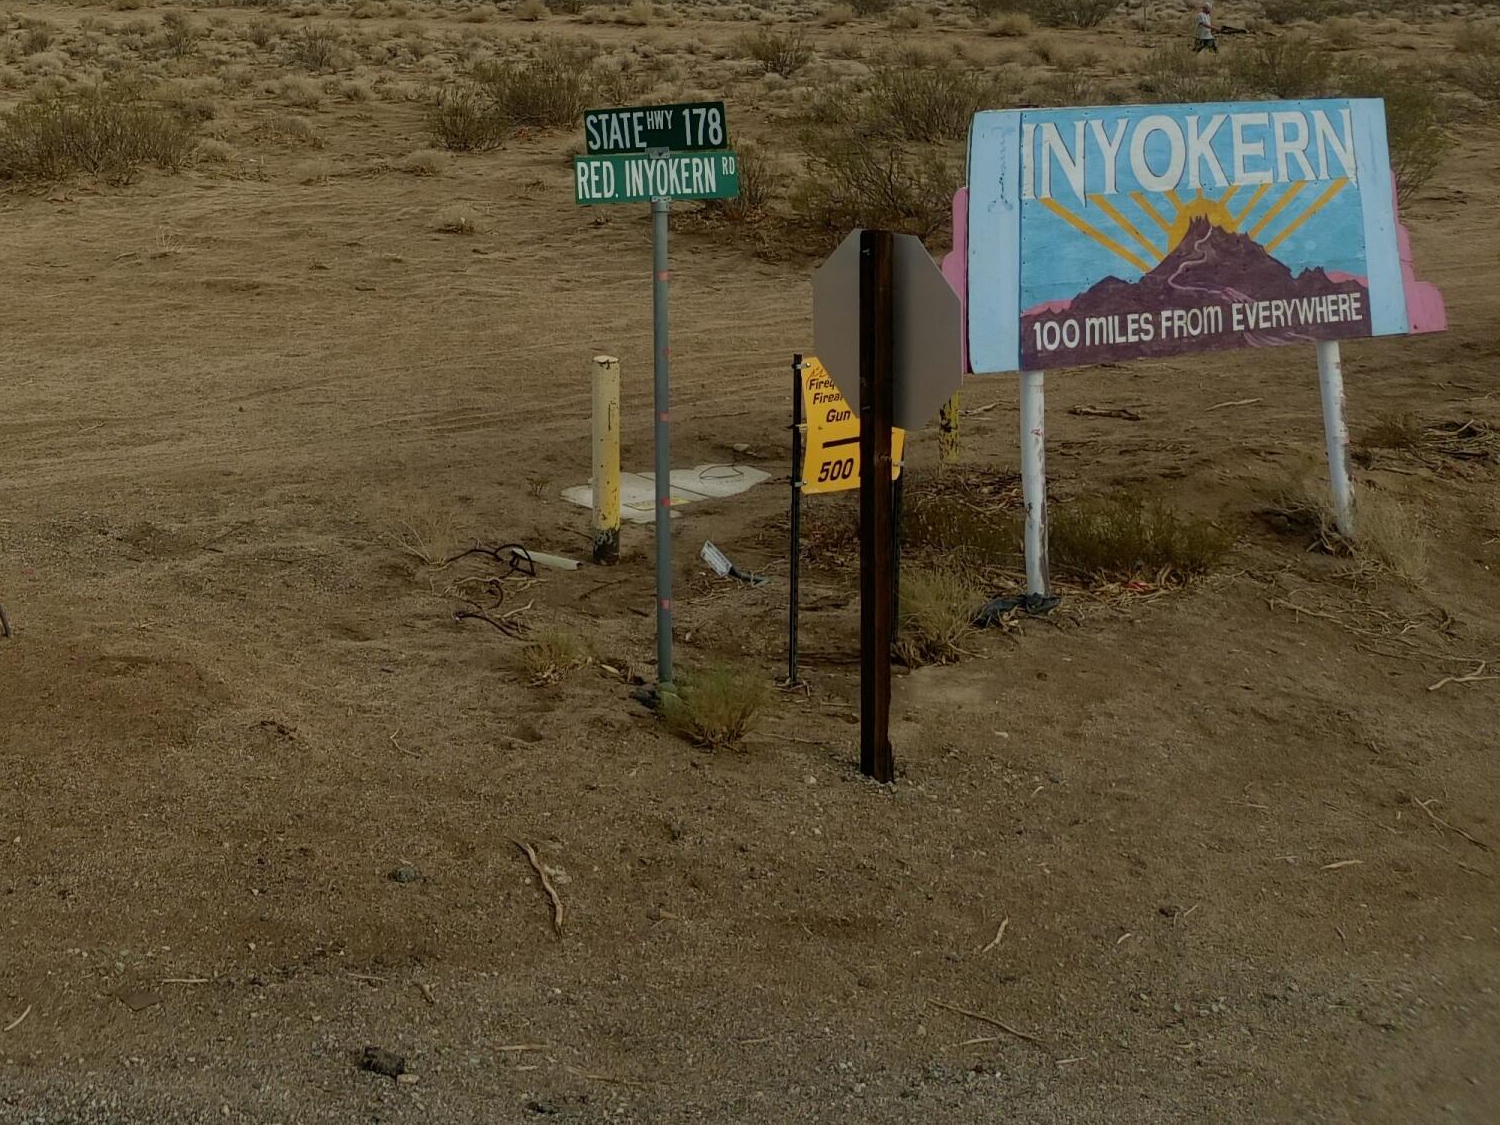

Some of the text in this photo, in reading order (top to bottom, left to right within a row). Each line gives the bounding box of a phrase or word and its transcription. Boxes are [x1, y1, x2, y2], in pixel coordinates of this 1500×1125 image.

[586, 108, 723, 150] STATE HWY 178
[625, 157, 716, 197] INYOKERN
[722, 156, 735, 174] RD
[1022, 109, 1358, 206] INYOKERN
[1033, 321, 1081, 352] 100
[1232, 292, 1363, 333] EVERYWHERE
[826, 408, 851, 423] Gun
[817, 457, 855, 483] 500
